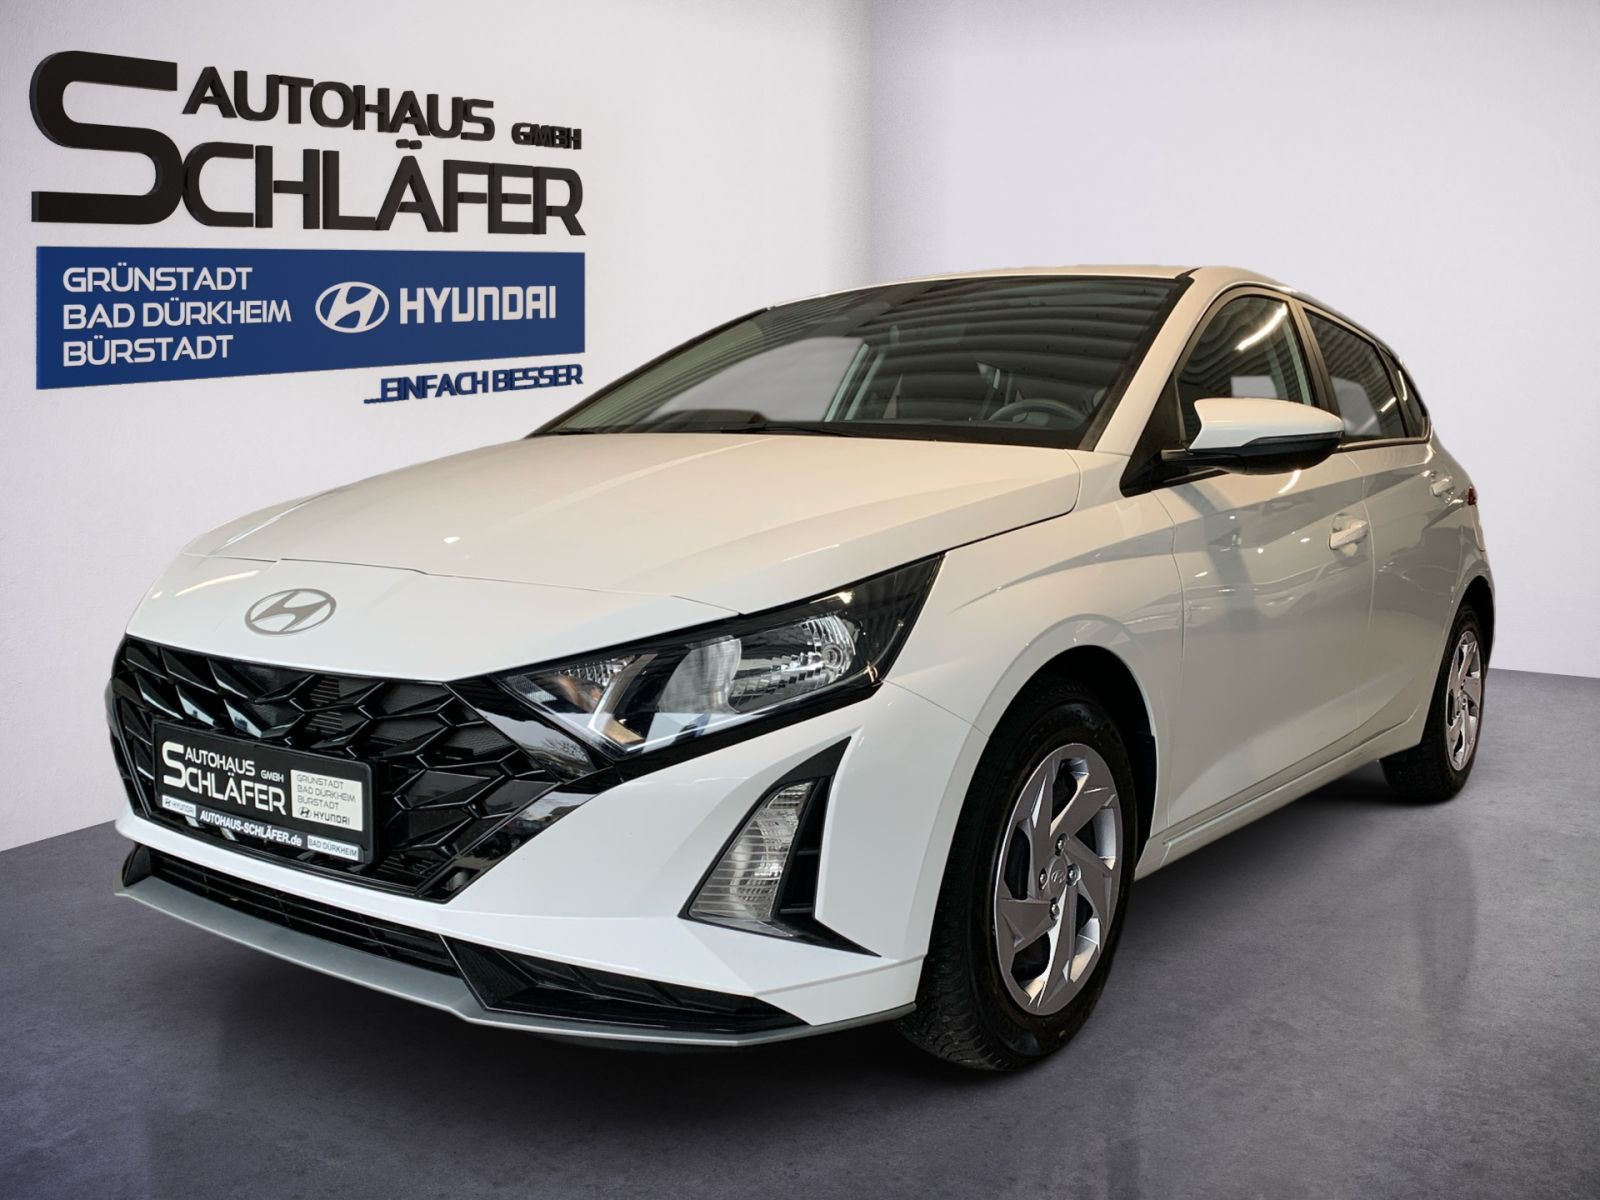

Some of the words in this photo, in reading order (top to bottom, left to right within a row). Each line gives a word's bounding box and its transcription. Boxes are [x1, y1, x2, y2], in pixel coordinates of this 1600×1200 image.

[182, 66, 495, 142] AUTOHAUS
[511, 122, 583, 150] GMBH
[29, 50, 587, 236] SCHLÄFER
[62, 262, 253, 294] GRÜNSTADT
[62, 302, 136, 330] BAD
[142, 297, 292, 326] DÜRKHEIM
[399, 285, 556, 325] HYUNDAI
[62, 334, 234, 367] BÜRSTADT
[492, 363, 583, 393] BESSER
[162, 740, 287, 816] SCHLÄFER
[185, 747, 255, 776] AUTOHAUS
[260, 769, 284, 783] GMBH
[297, 784, 314, 795] BAD
[200, 810, 303, 847] AUTOHAUS-SCHLÄFER.de
[313, 810, 351, 826] HYUNDAI
[308, 837, 322, 849] BAD
